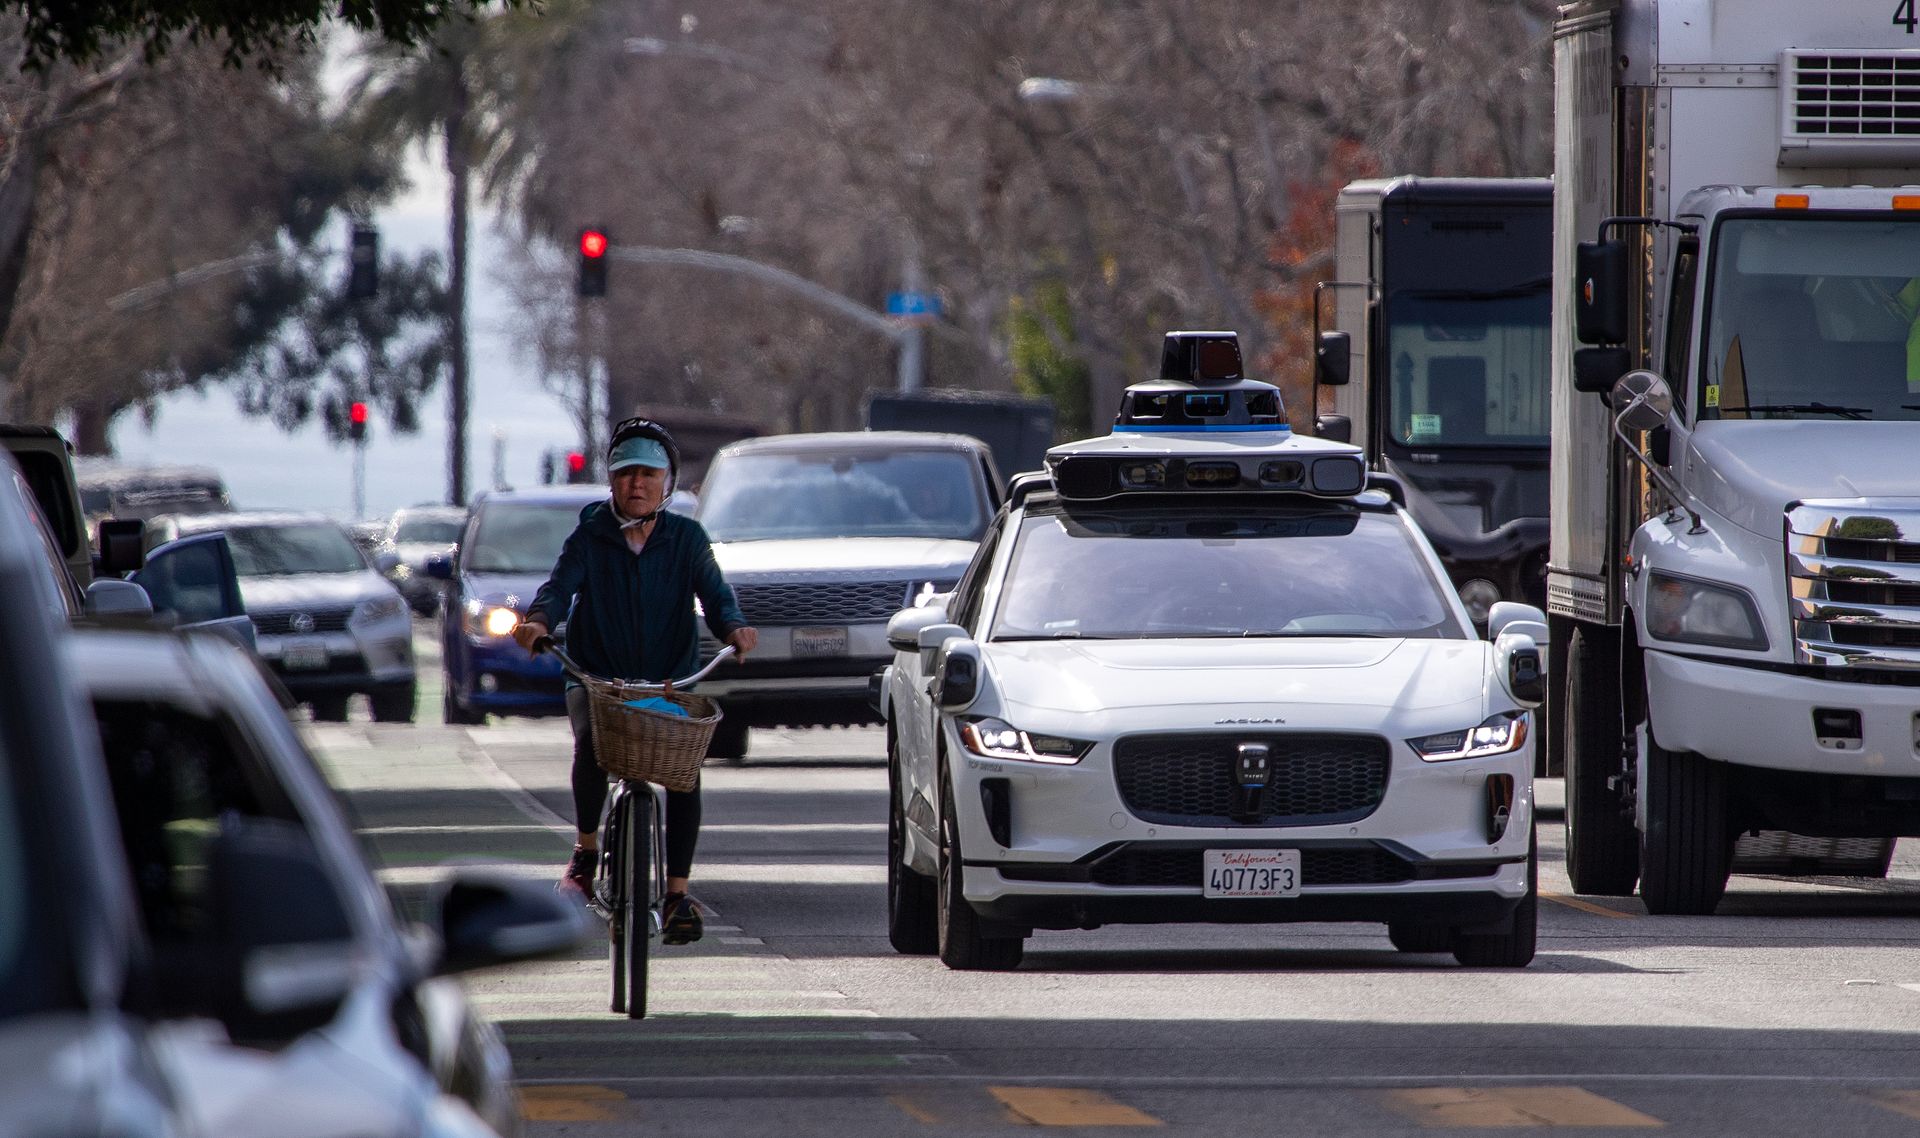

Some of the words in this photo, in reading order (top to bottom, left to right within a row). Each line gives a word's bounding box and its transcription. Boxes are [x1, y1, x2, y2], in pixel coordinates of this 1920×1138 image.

[1892, 0, 1918, 34] 4
[1224, 853, 1281, 867] California
[1210, 868, 1294, 891] 40773F3
